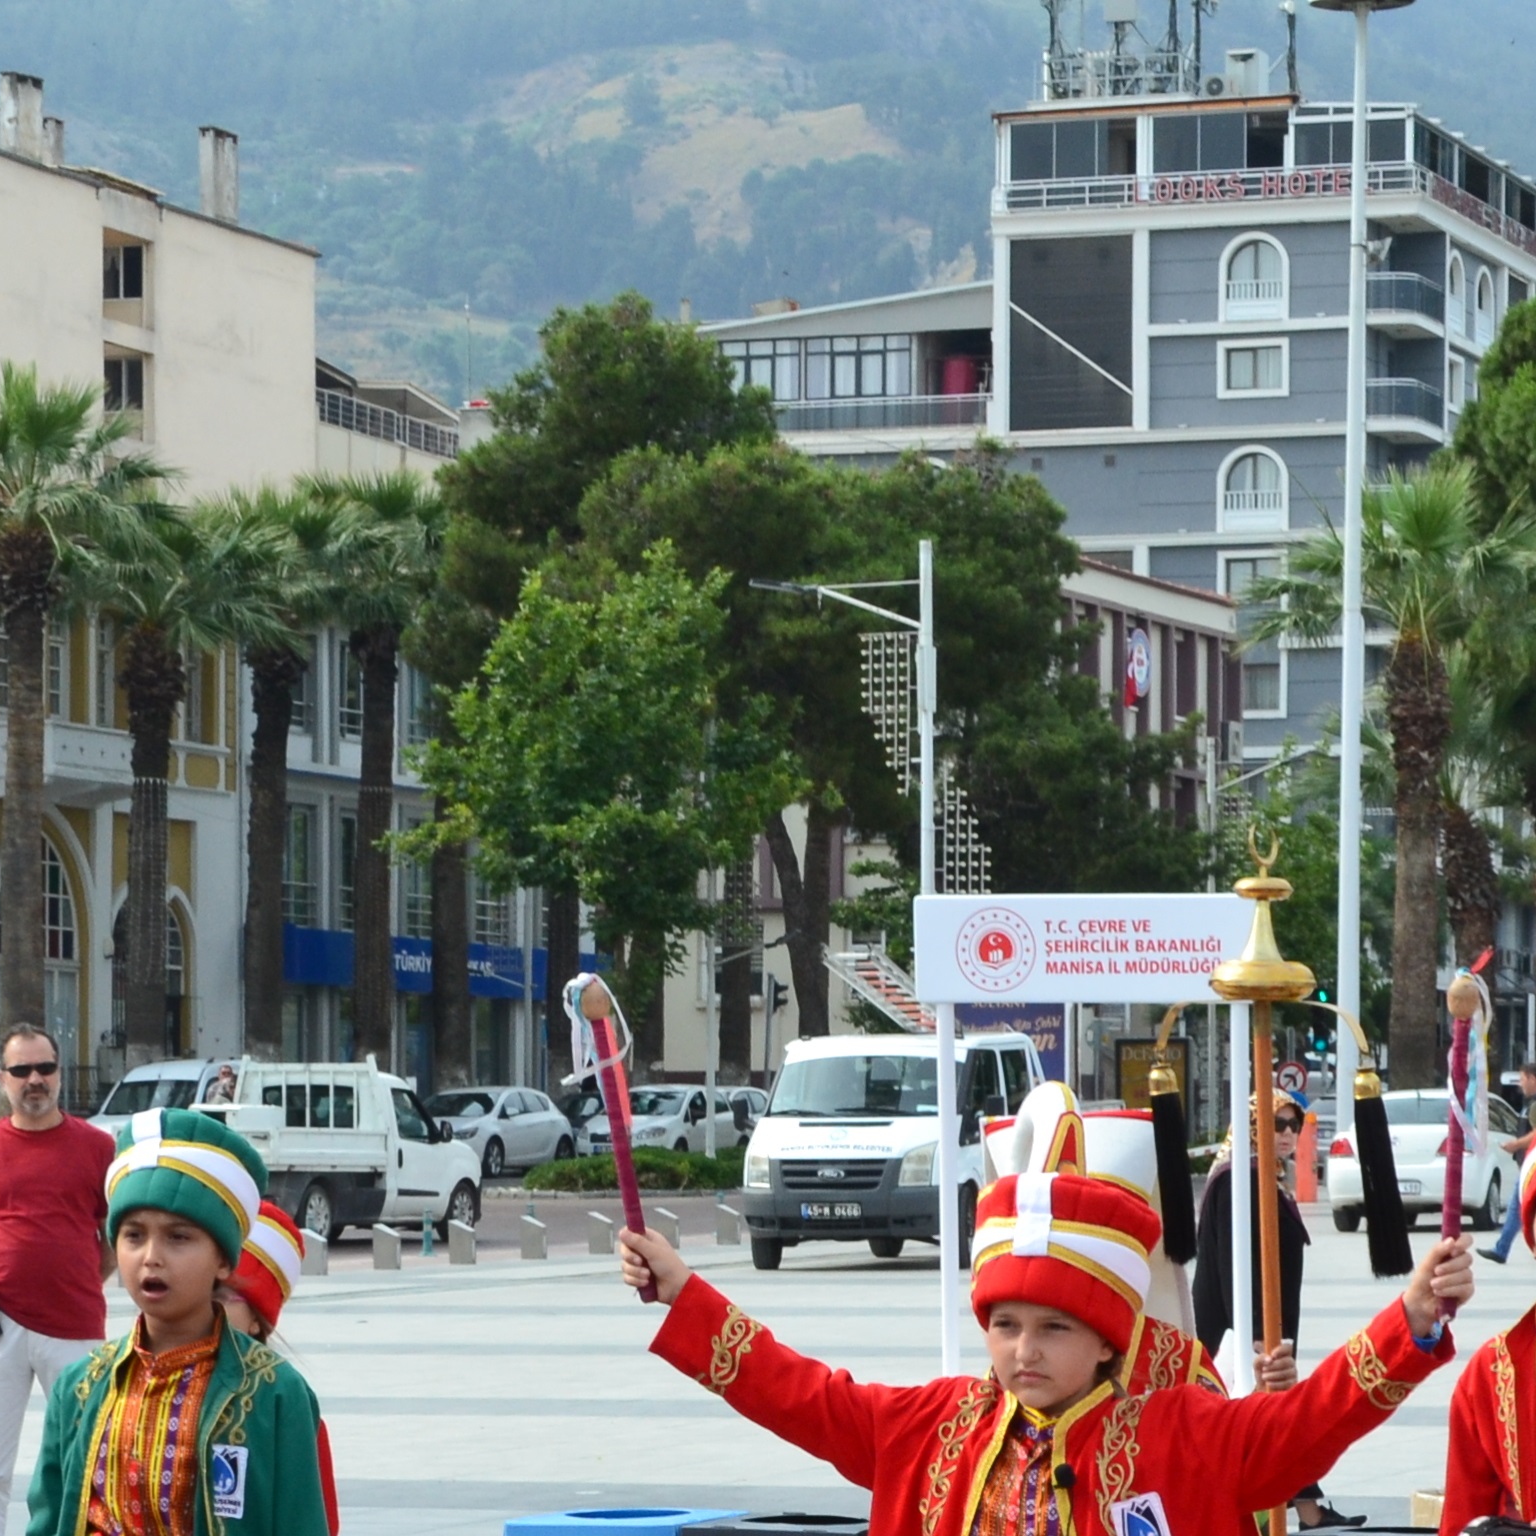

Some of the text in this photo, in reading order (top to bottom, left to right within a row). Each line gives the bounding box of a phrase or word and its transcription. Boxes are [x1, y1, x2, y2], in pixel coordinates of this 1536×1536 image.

[1133, 168, 1374, 205] LOOKS HOTE
[1044, 919, 1152, 937] T.C. ÇEVRE VE
[1045, 935, 1222, 957] ŞEHİRCİLİK BAKANLIĞI
[1045, 957, 1105, 974] MANİSA
[1108, 958, 1121, 974] İL
